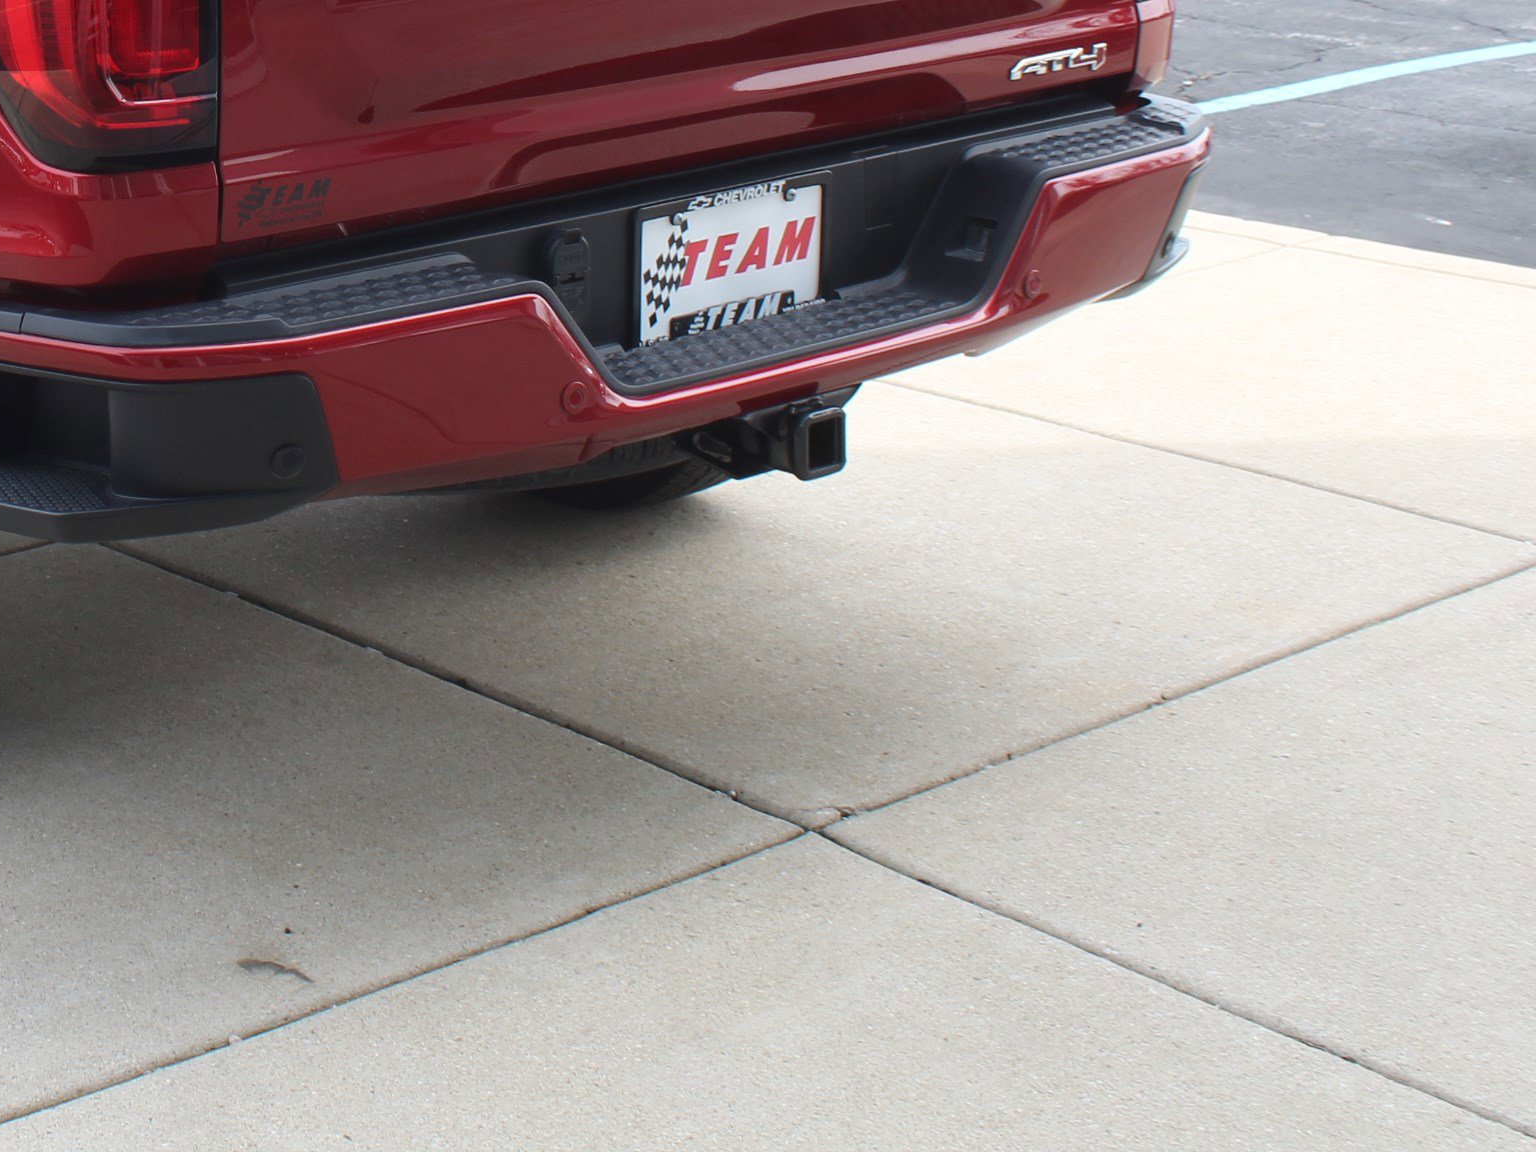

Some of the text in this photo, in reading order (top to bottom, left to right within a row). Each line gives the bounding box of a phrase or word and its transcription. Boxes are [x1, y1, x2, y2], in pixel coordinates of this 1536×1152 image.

[1009, 42, 1108, 81] AT4
[256, 176, 332, 210] TEAM
[713, 180, 786, 207] CHEVROLET
[680, 216, 816, 287] TEAM
[706, 291, 782, 331] TEAM
